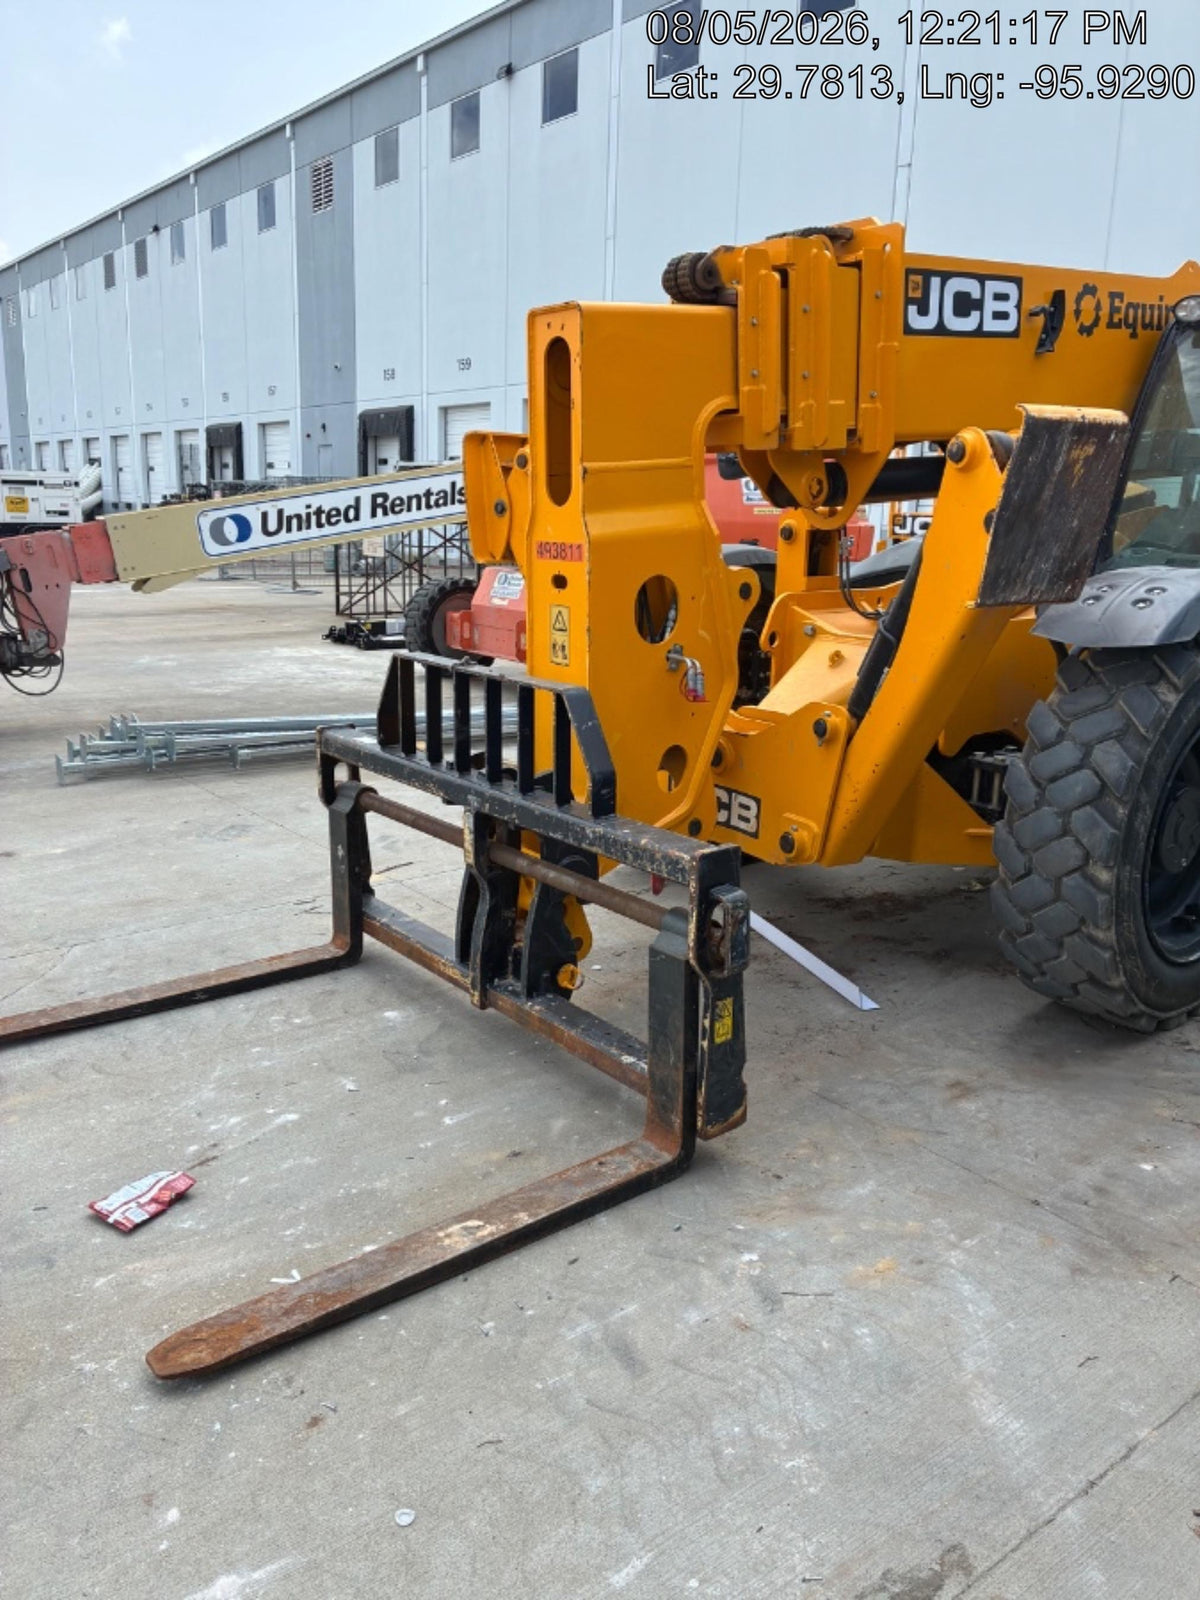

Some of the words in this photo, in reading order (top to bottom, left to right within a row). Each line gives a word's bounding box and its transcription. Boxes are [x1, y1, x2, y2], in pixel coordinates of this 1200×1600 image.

[907, 275, 1020, 333] JCB
[261, 496, 361, 537] United
[370, 480, 467, 518] Rentals
[536, 541, 583, 561] 493811
